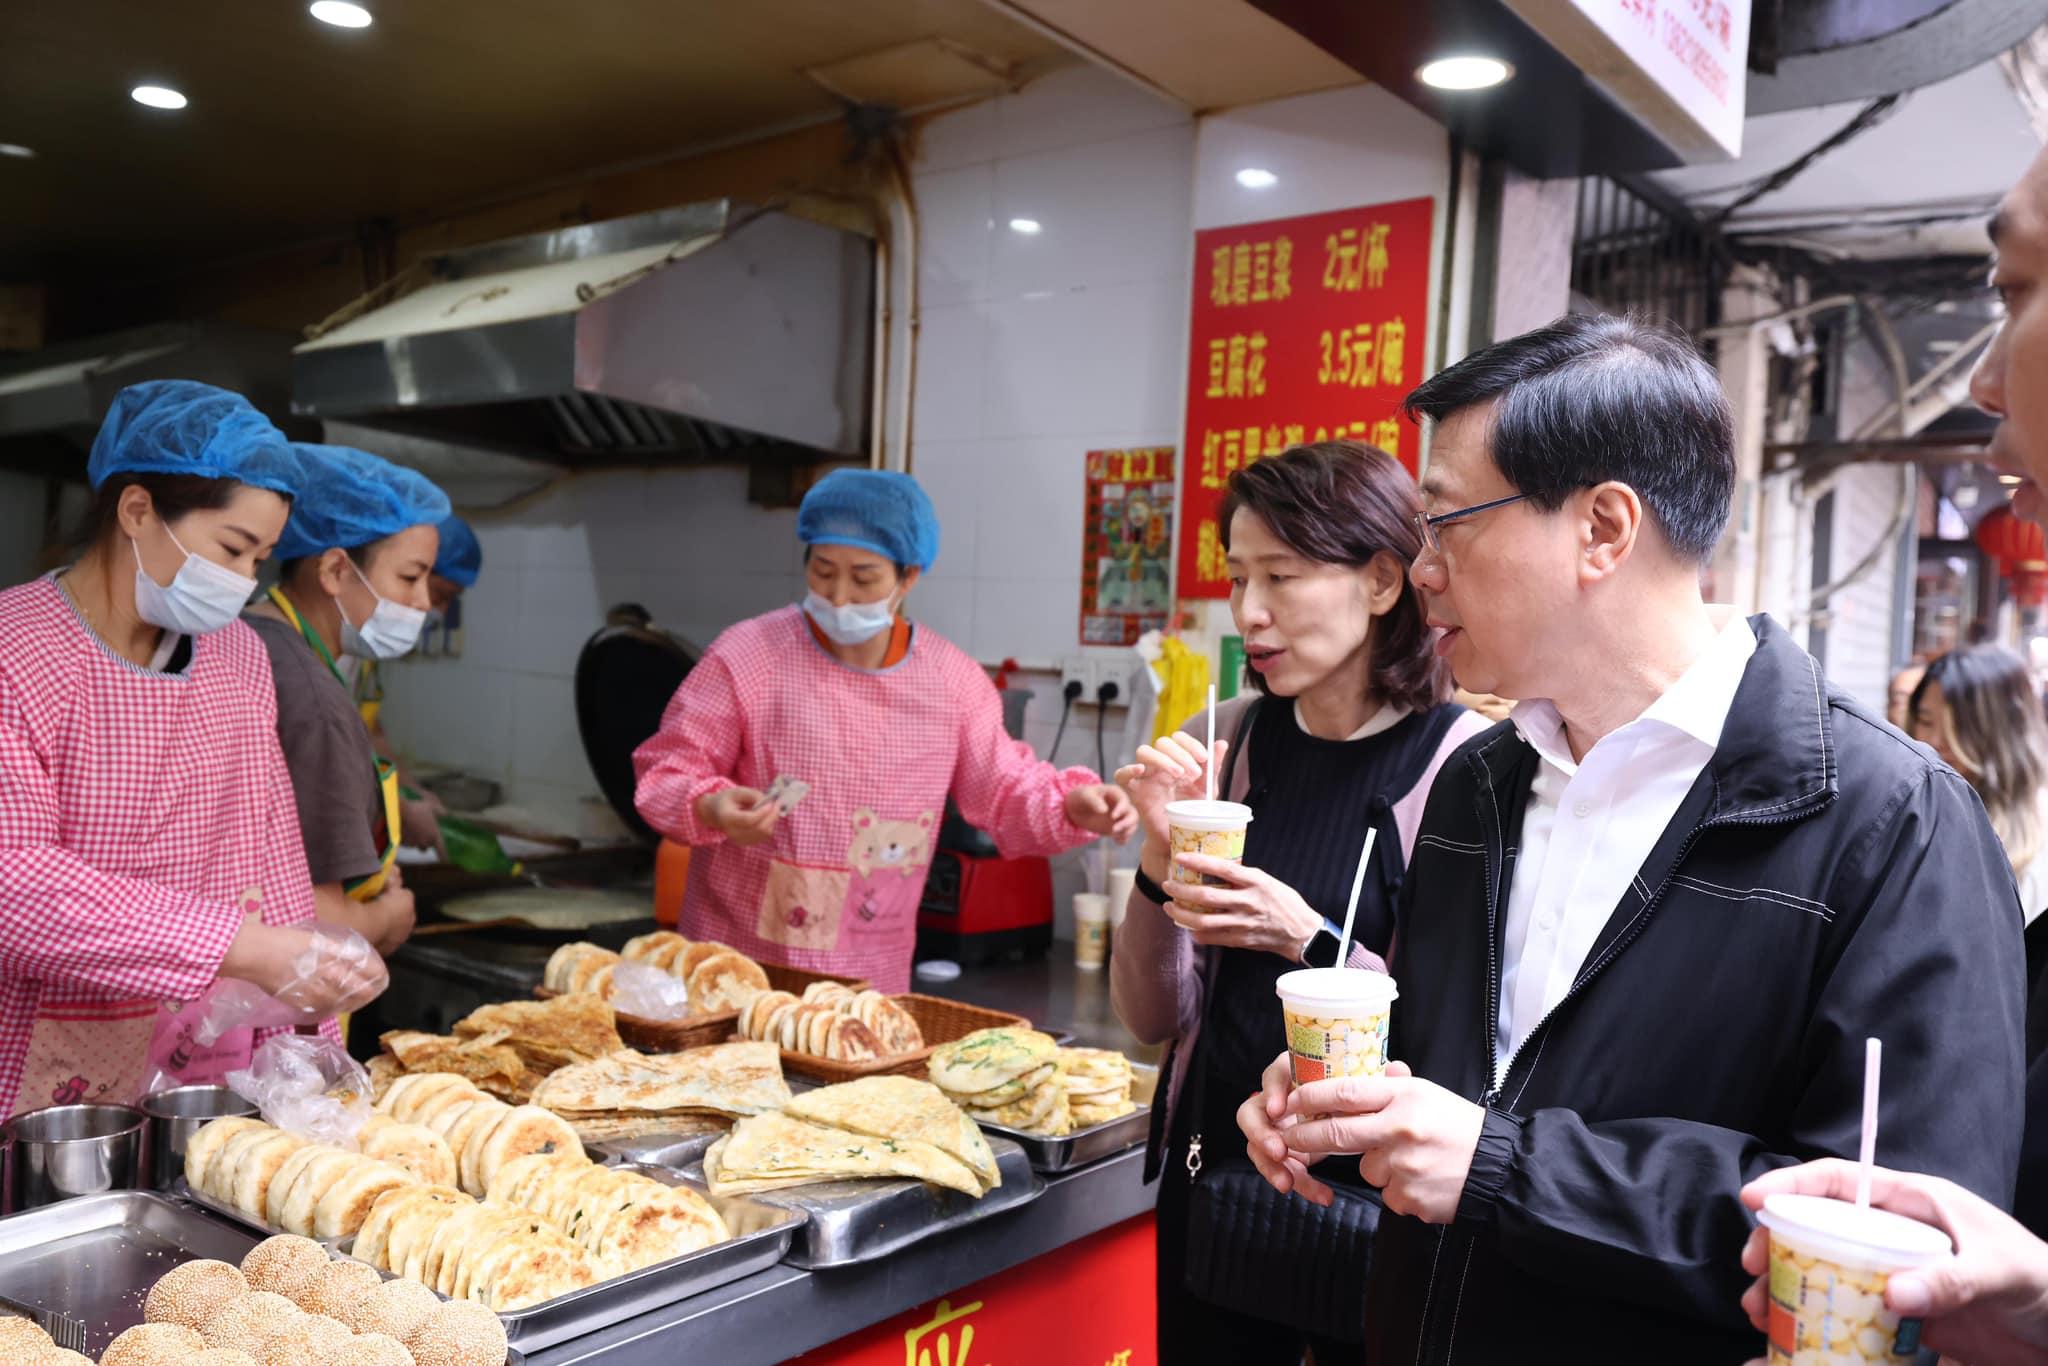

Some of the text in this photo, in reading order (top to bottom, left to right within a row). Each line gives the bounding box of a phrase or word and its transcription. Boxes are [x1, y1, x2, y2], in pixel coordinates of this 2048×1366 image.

[1323, 222, 1391, 292] 2元/杯
[1206, 315, 1405, 399] 豆腐花 3.5元/碗
